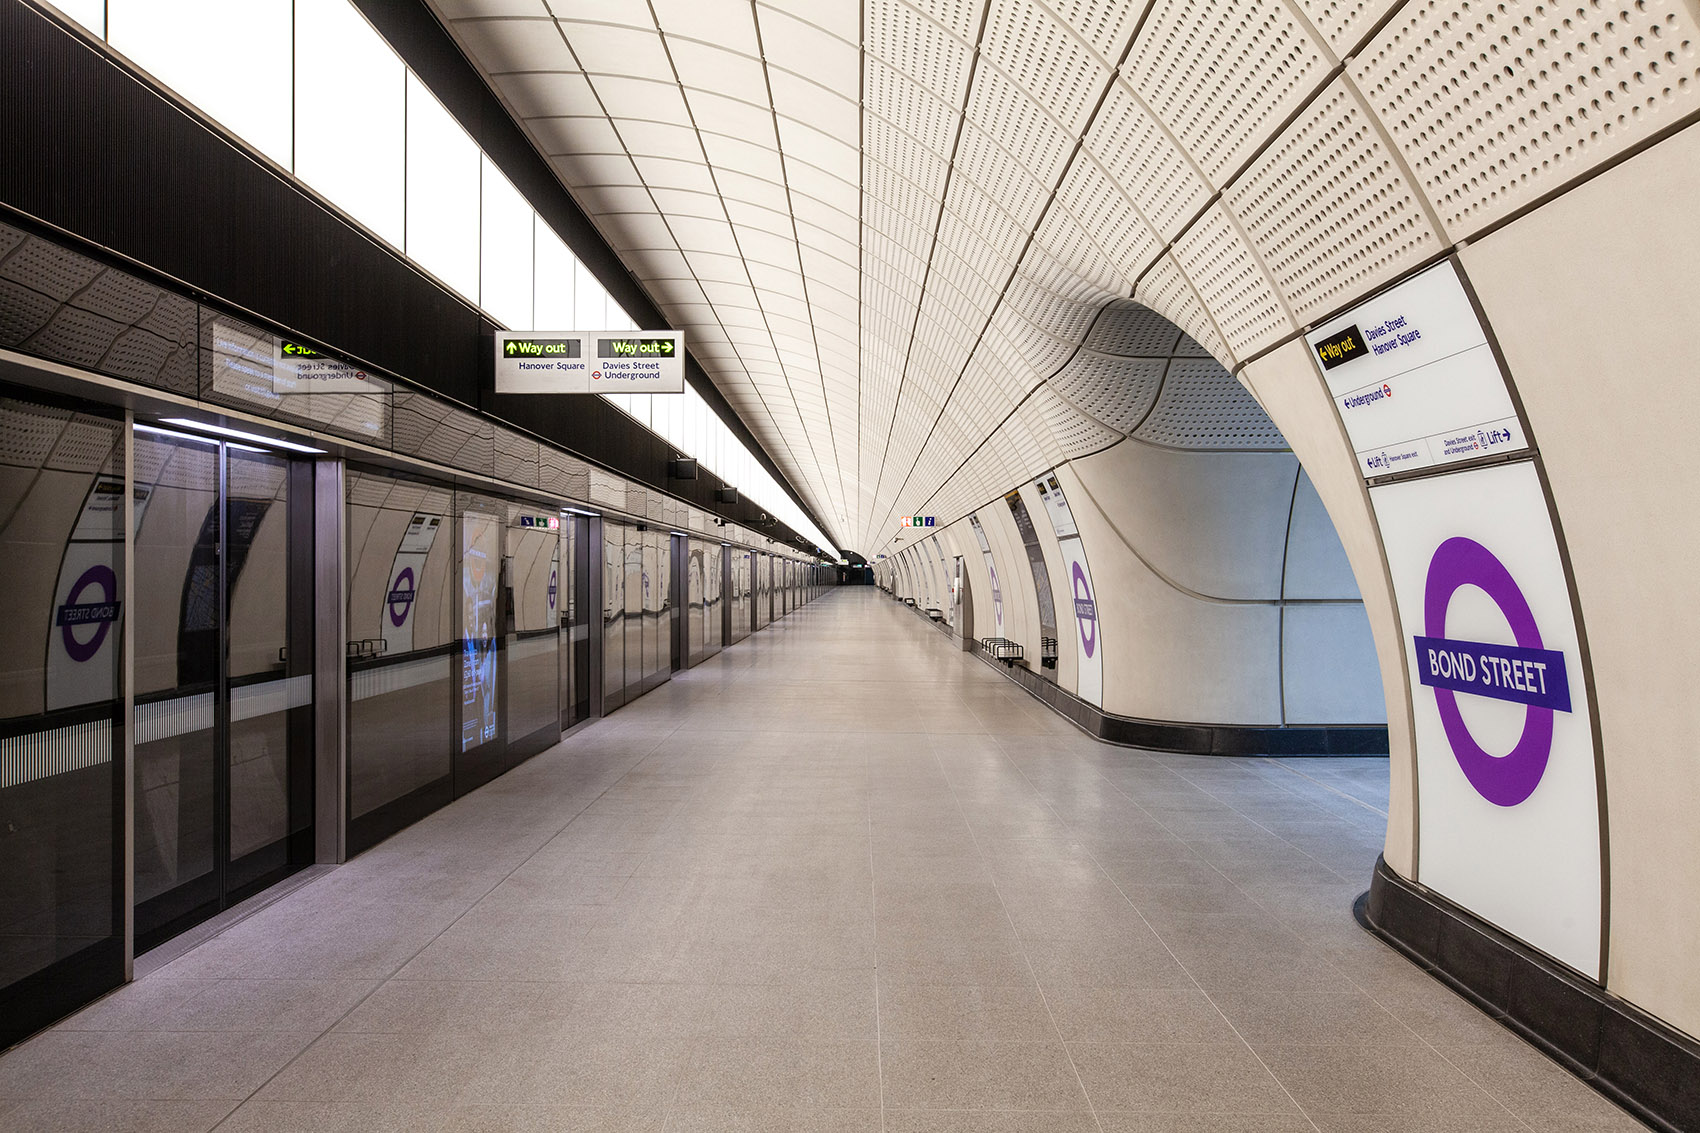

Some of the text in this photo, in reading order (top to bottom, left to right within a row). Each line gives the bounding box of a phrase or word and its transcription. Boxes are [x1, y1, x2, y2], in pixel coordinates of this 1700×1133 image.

[1365, 315, 1407, 341] Davies Street
[518, 342, 566, 356] Way out
[612, 342, 660, 356] Way out
[1324, 336, 1356, 358] Way out
[1372, 329, 1421, 356] Hanover Square
[518, 361, 585, 371] Hanover Square
[602, 361, 660, 370] Davies Street
[604, 371, 660, 380] Underground
[1348, 387, 1384, 408] Underground
[1456, 436, 1469, 444] Street
[1486, 430, 1504, 445] Lift
[1450, 444, 1474, 454] Underground
[1371, 456, 1384, 468] Lift
[1428, 648, 1547, 694] BOND STREET
